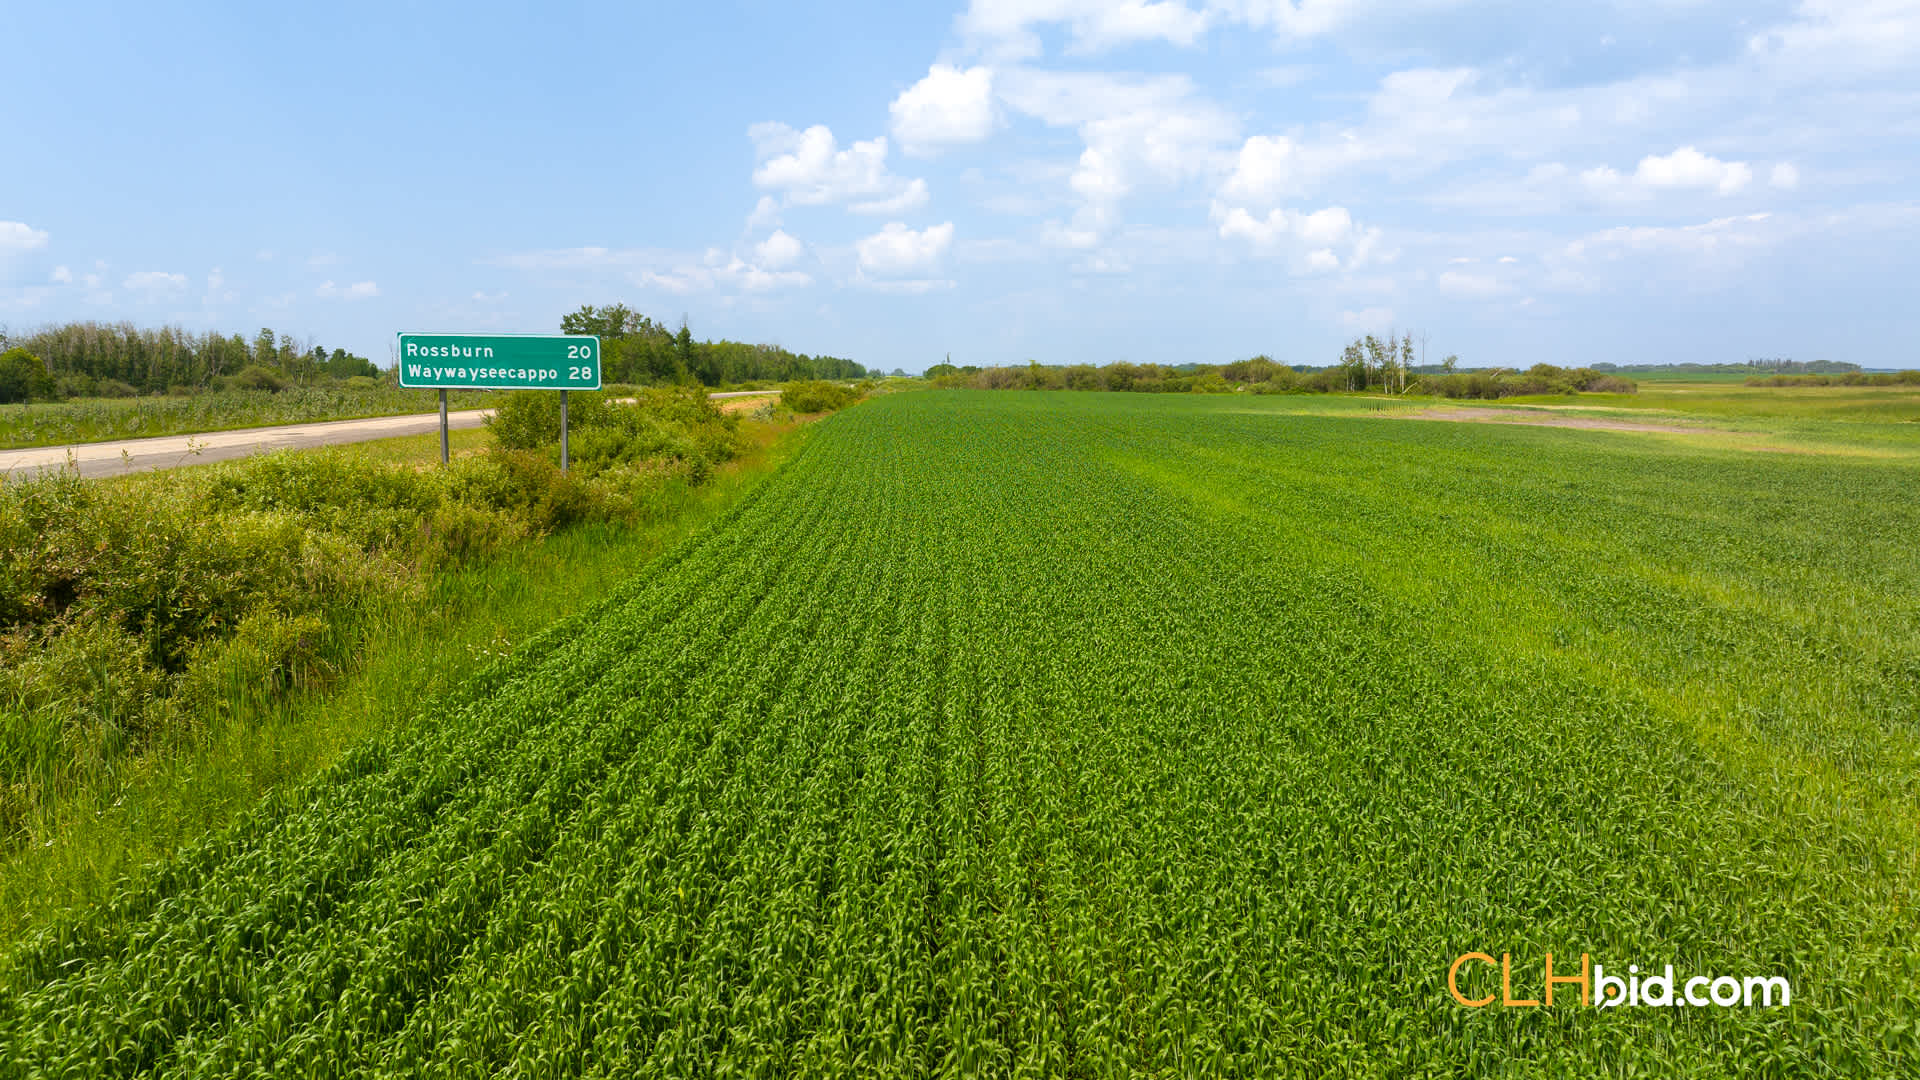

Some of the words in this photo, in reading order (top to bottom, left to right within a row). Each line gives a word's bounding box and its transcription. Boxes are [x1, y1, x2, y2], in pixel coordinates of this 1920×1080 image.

[407, 343, 494, 358] Rossburn
[567, 345, 591, 359] 20
[408, 364, 558, 382] Waywayseecappo
[569, 366, 592, 380] 28
